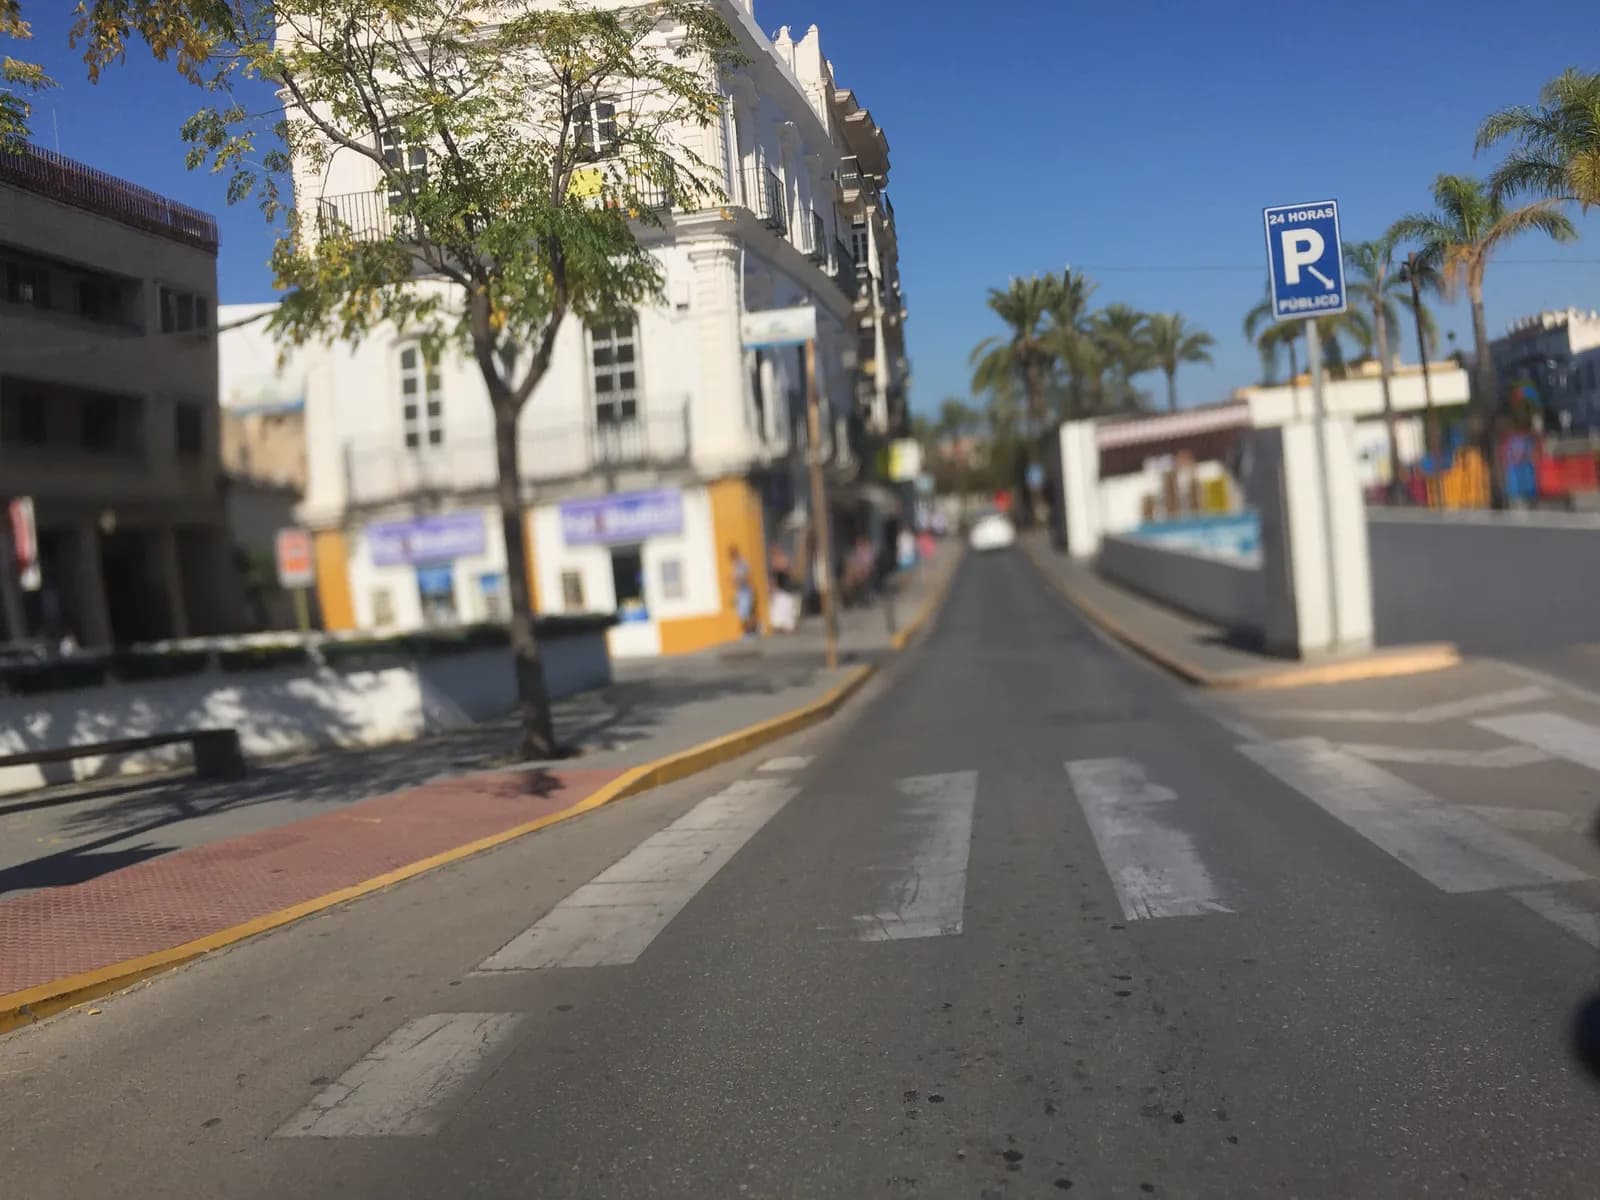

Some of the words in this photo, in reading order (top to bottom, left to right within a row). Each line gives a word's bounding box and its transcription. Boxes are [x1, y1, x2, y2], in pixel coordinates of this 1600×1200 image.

[1269, 214, 1285, 225] 24
[1288, 208, 1334, 222] HORAS
[1281, 228, 1325, 285] P
